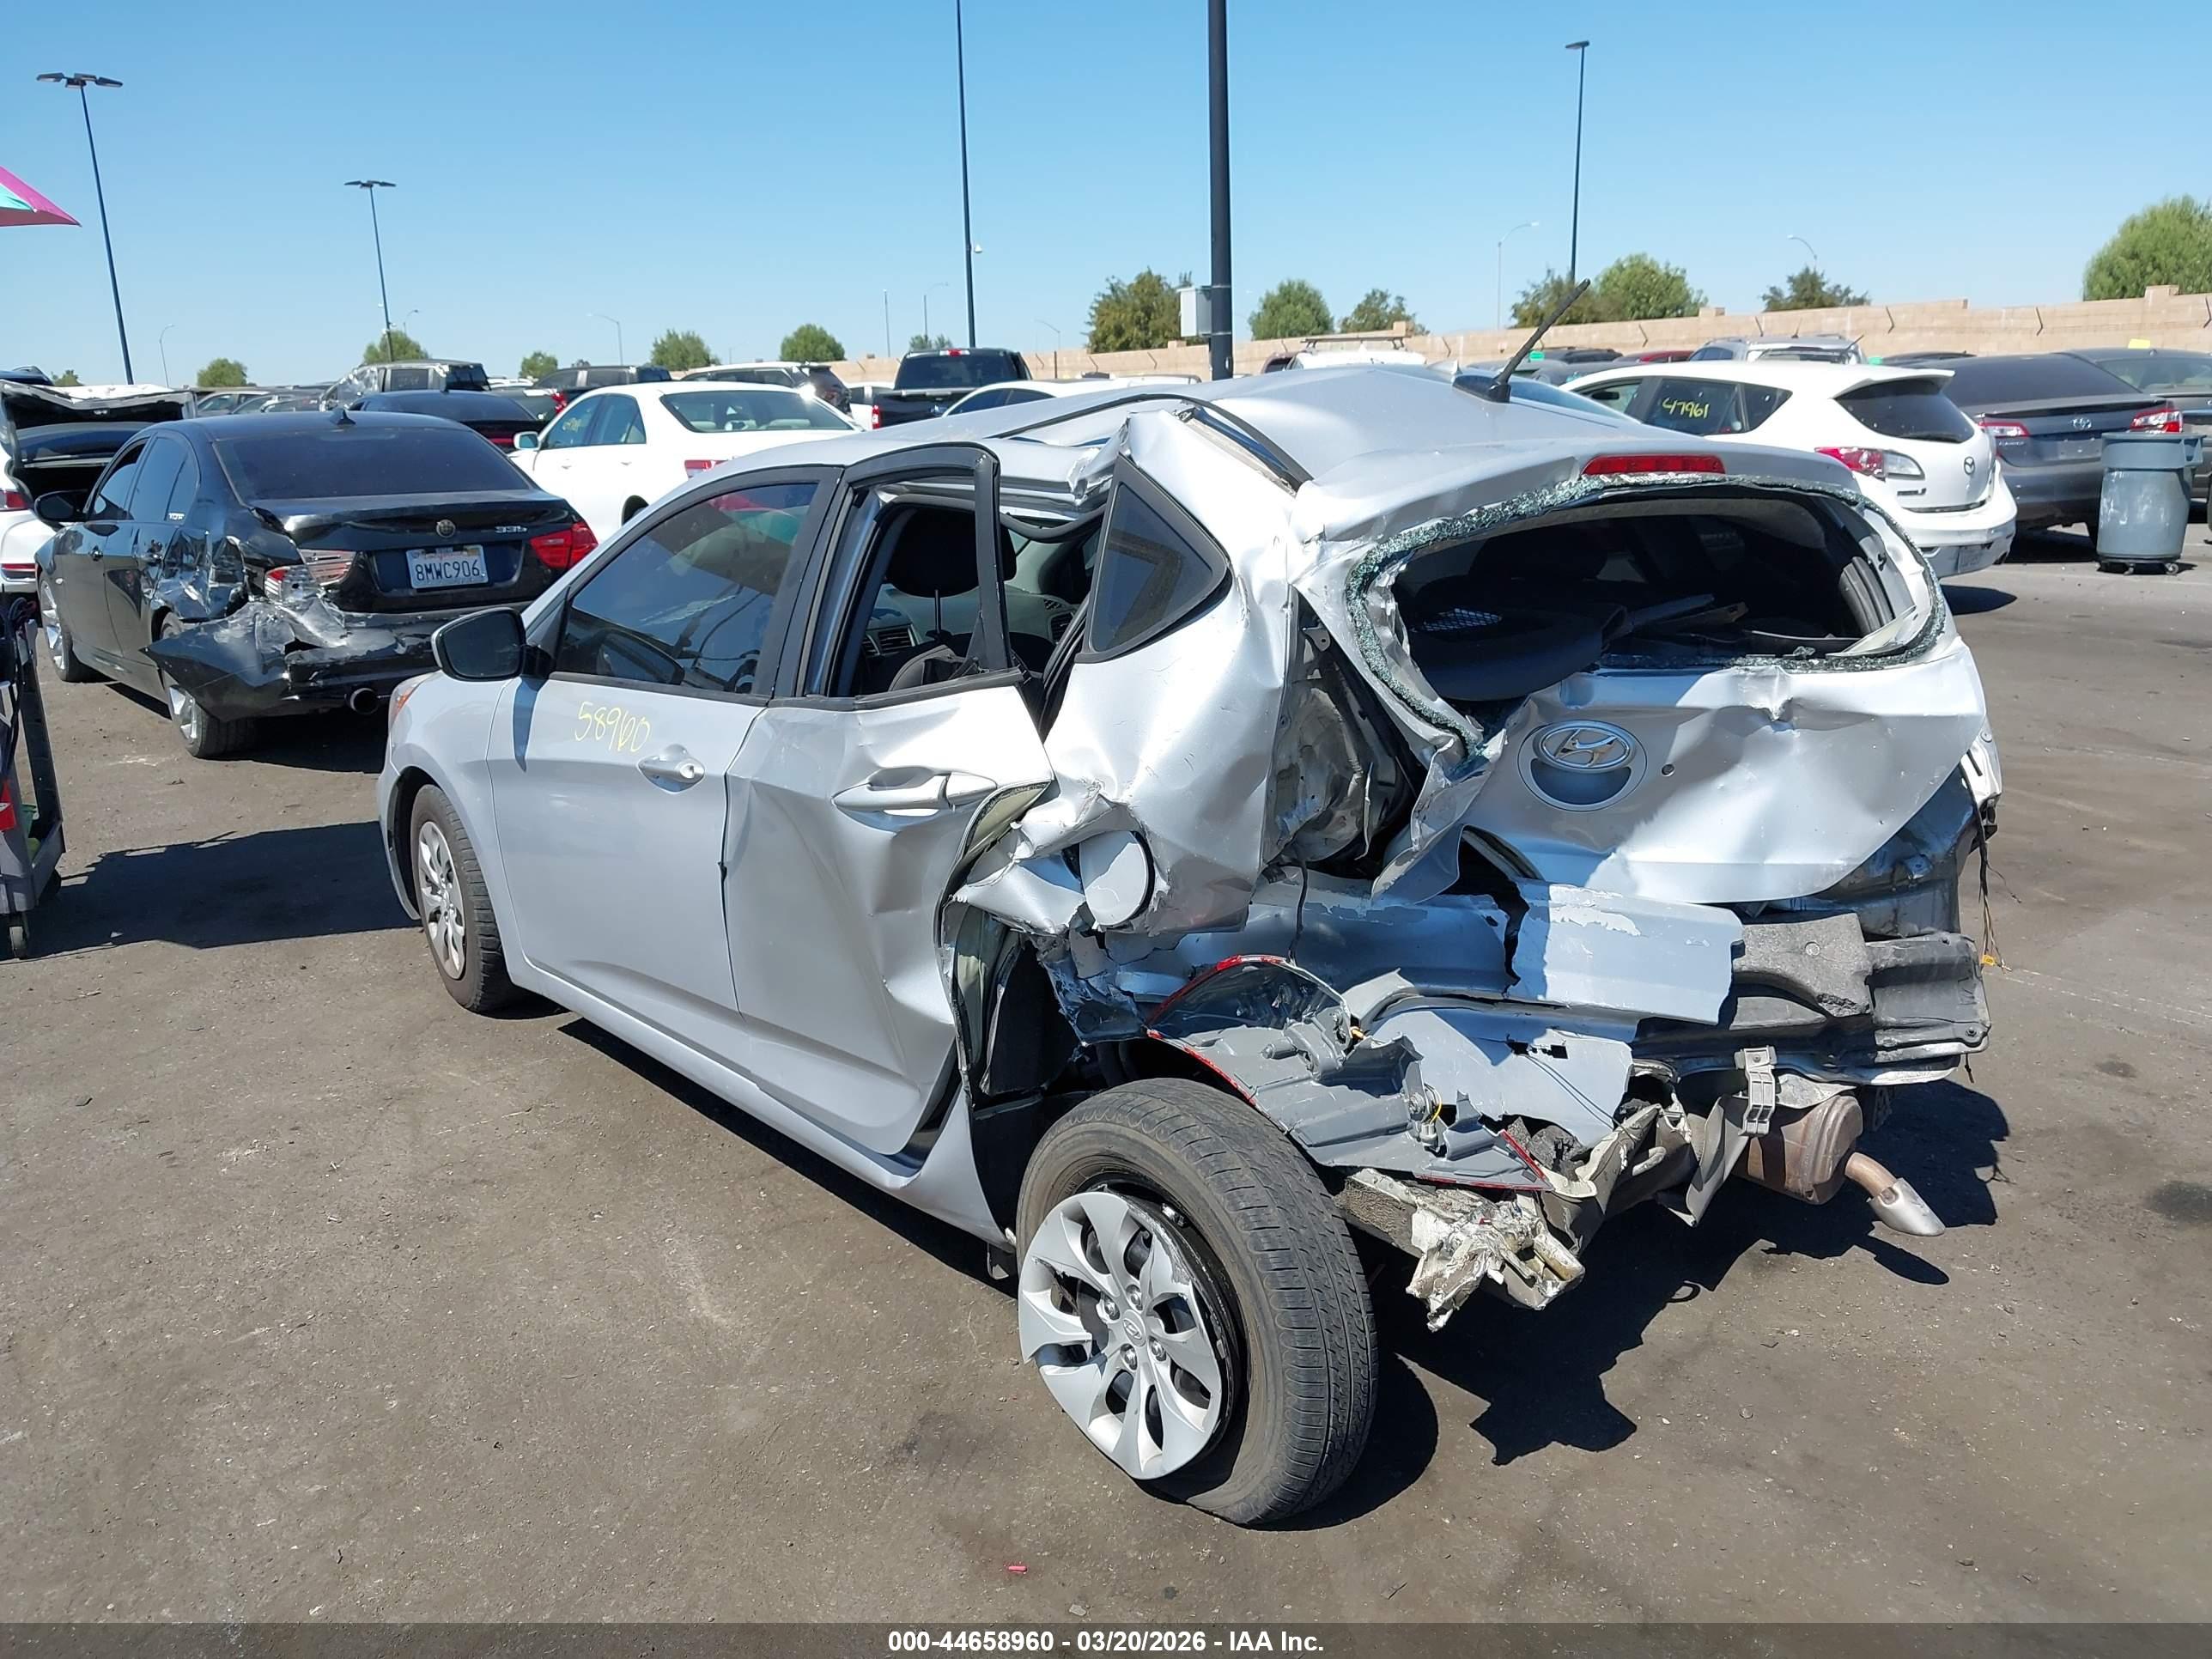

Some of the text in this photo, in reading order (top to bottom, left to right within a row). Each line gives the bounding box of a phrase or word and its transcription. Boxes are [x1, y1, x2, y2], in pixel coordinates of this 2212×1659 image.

[1662, 397, 1711, 419] 47961
[415, 559, 480, 581] 8MWC906
[574, 700, 651, 753] 58960
